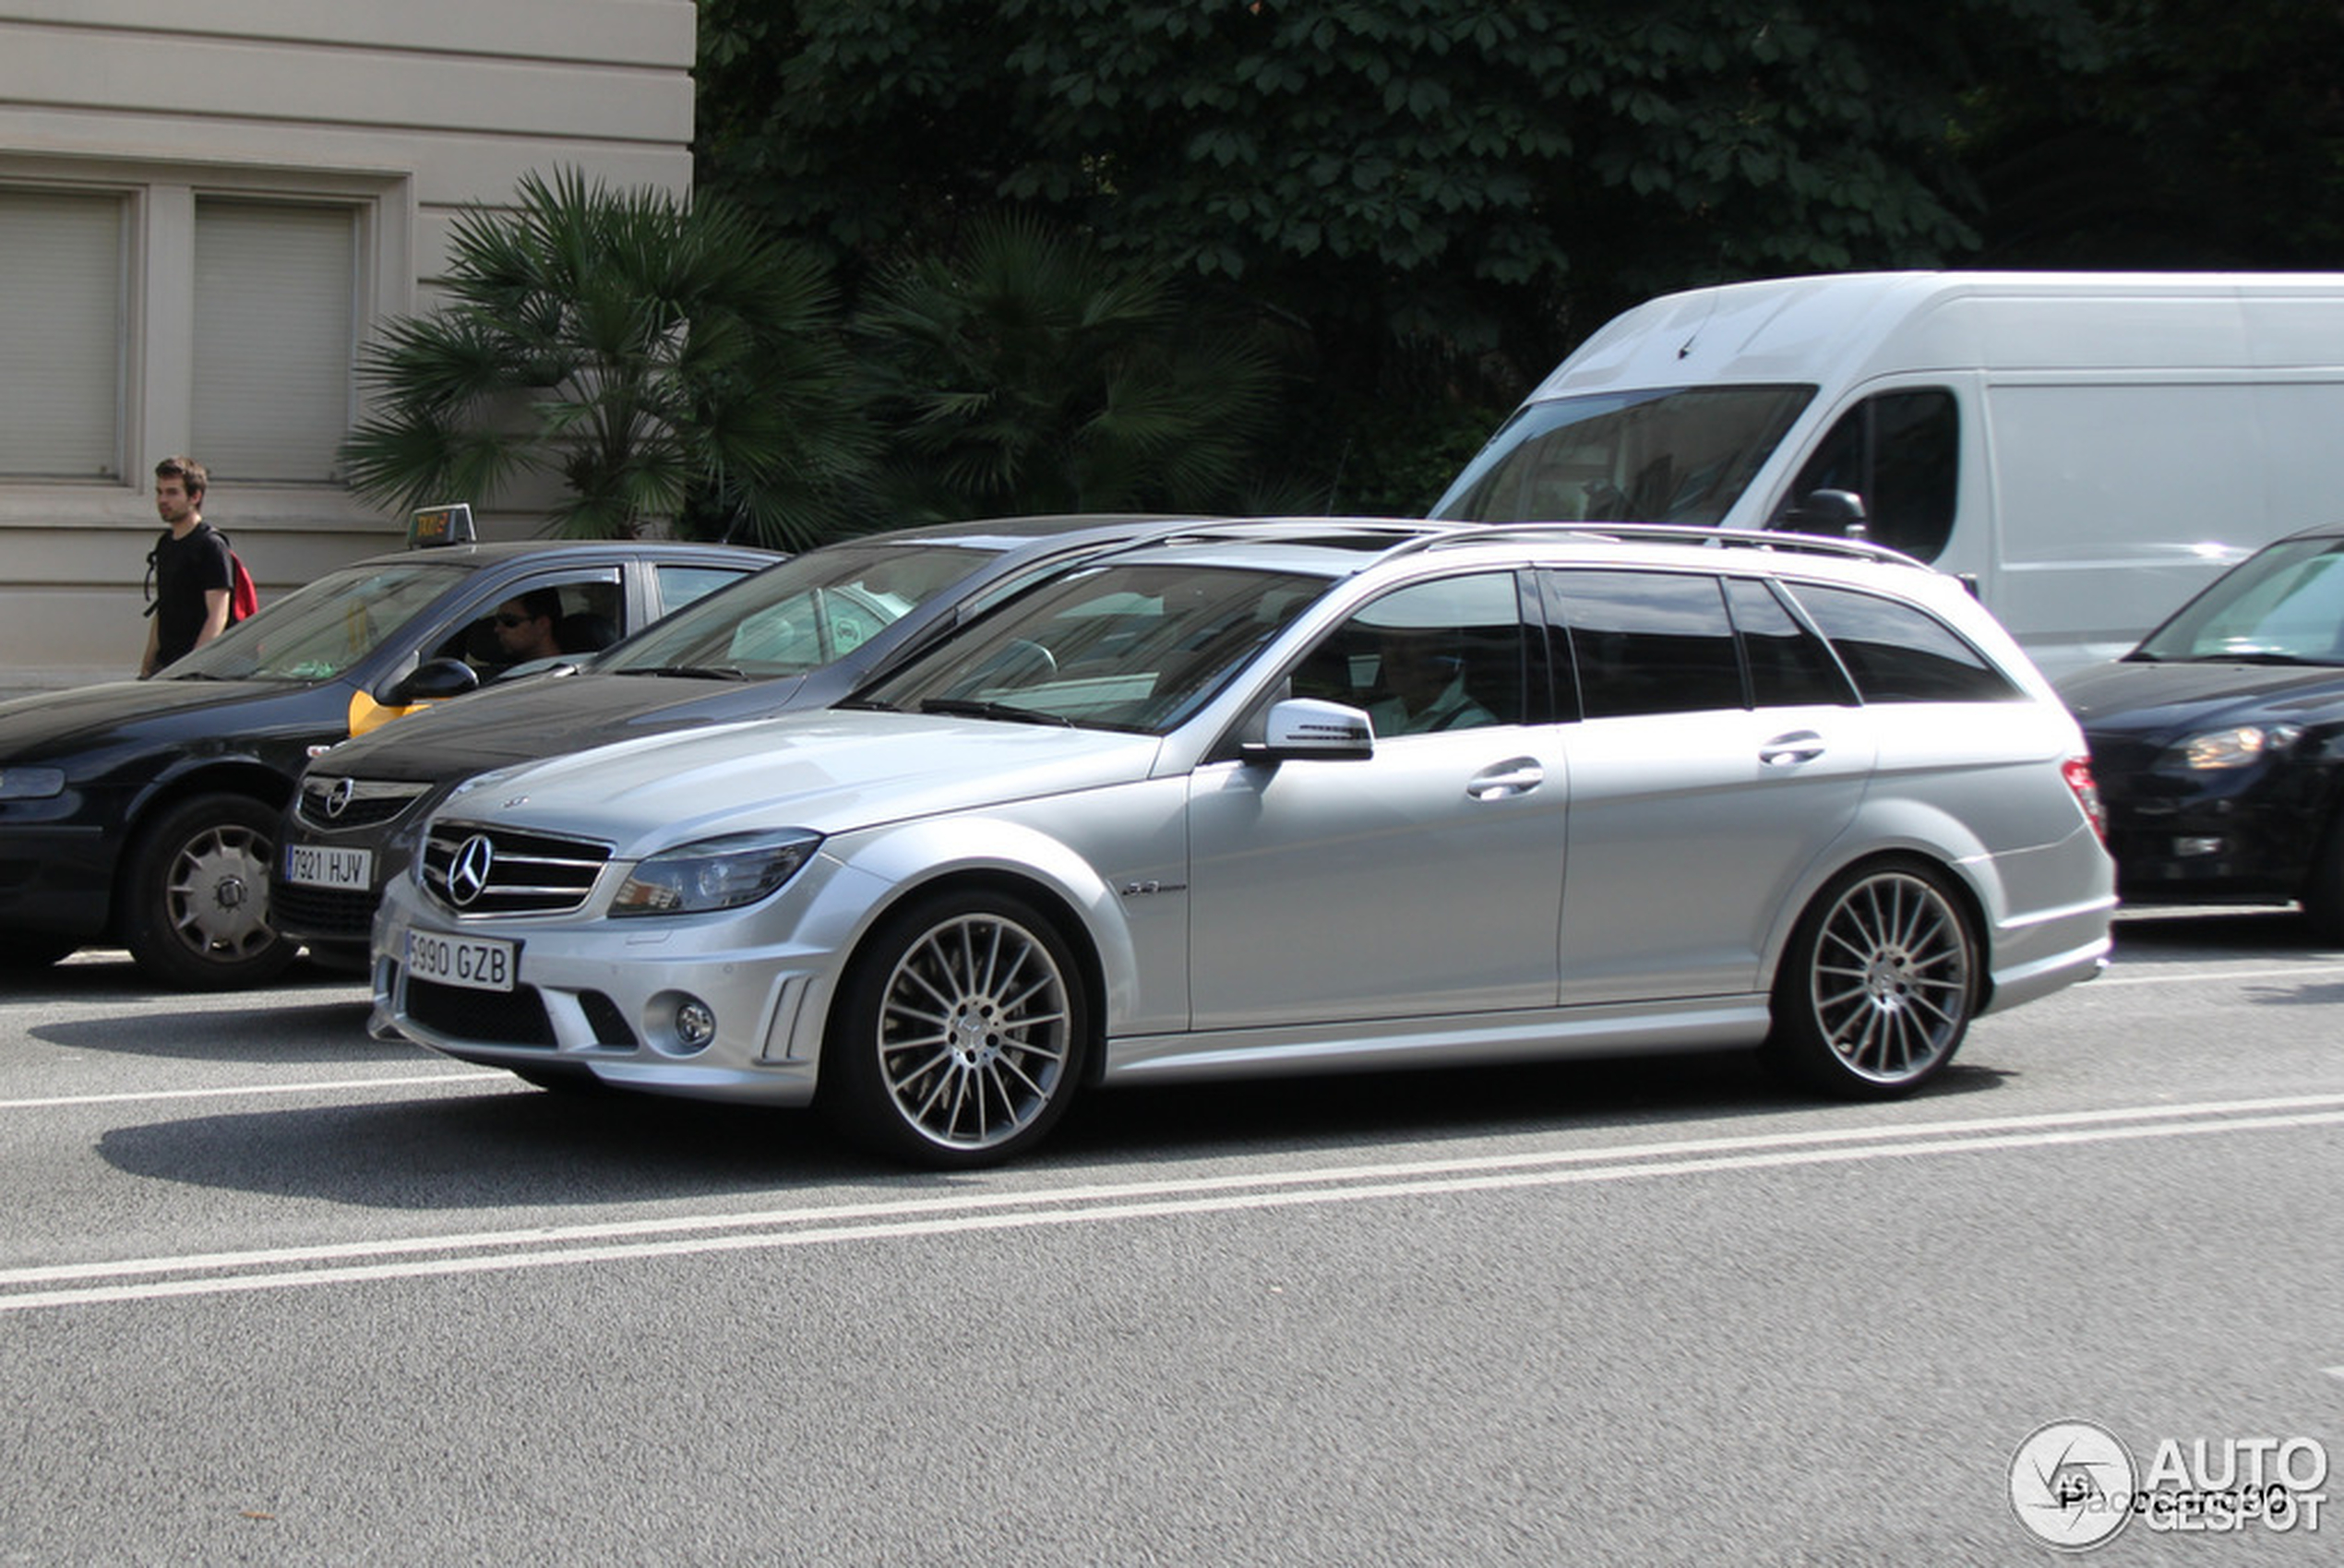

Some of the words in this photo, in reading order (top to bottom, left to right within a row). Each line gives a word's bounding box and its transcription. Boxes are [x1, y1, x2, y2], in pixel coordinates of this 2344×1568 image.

[293, 849, 321, 880] 7921
[329, 852, 363, 883] HJV
[410, 933, 448, 976] 5990
[458, 944, 506, 984] GZB
